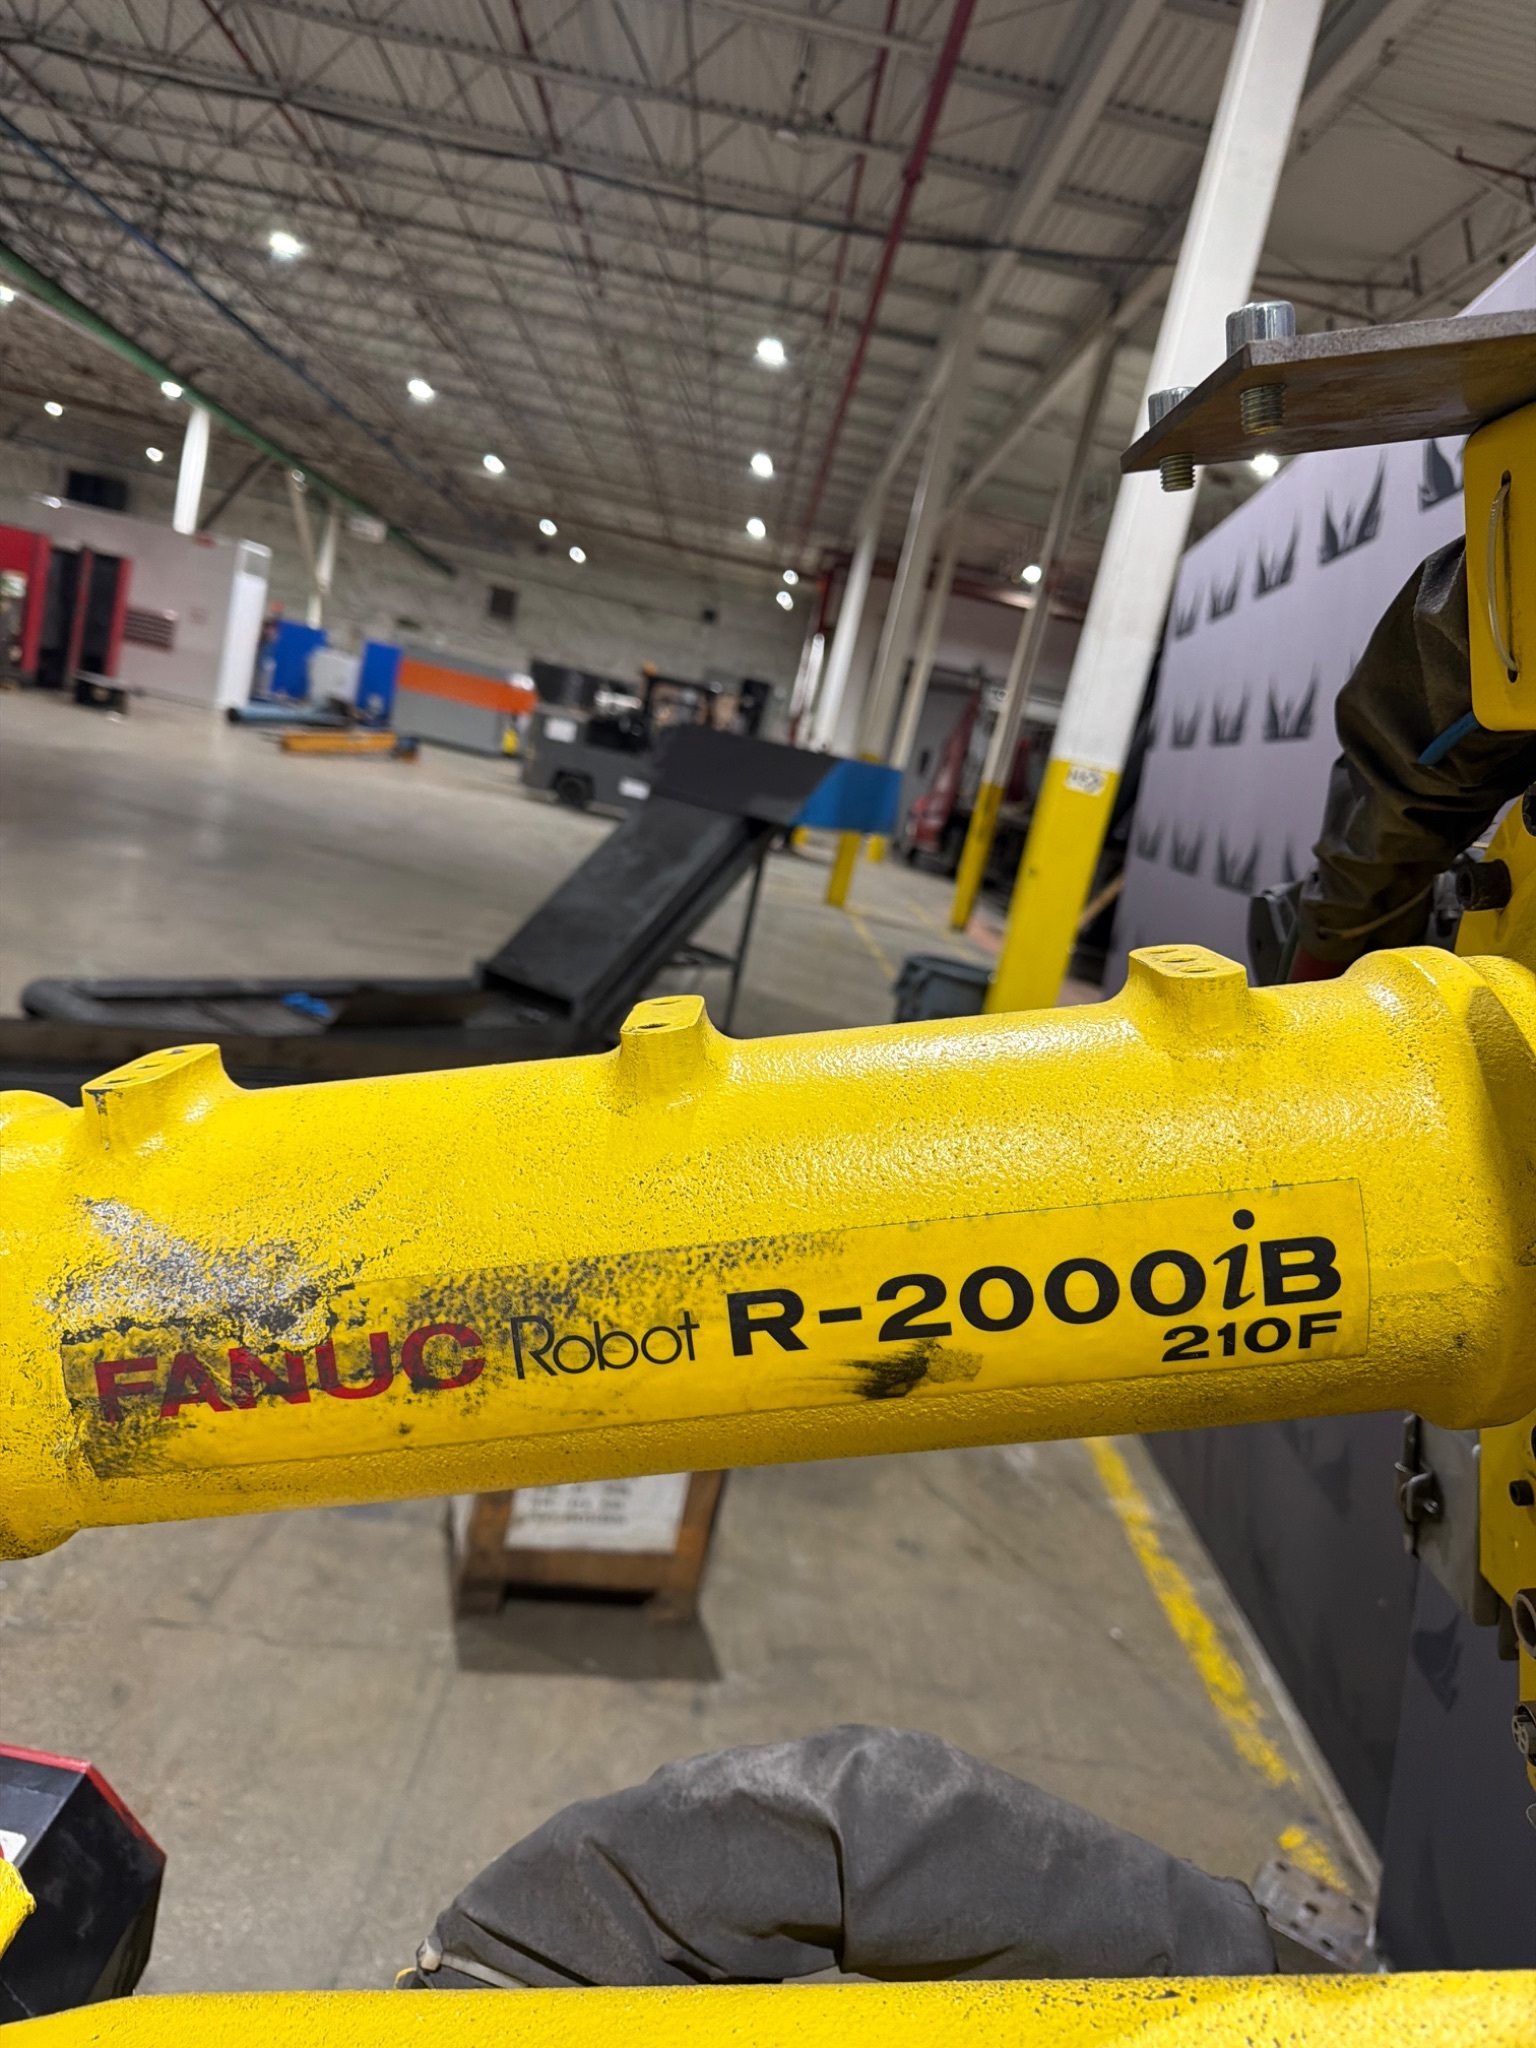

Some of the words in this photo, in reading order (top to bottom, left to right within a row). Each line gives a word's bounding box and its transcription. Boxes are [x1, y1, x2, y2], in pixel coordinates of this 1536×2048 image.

[94, 1323, 486, 1422] FANUC
[510, 1311, 700, 1380] Robot
[727, 1209, 1341, 1356] R-2000iB
[1161, 1311, 1342, 1362] 210F
